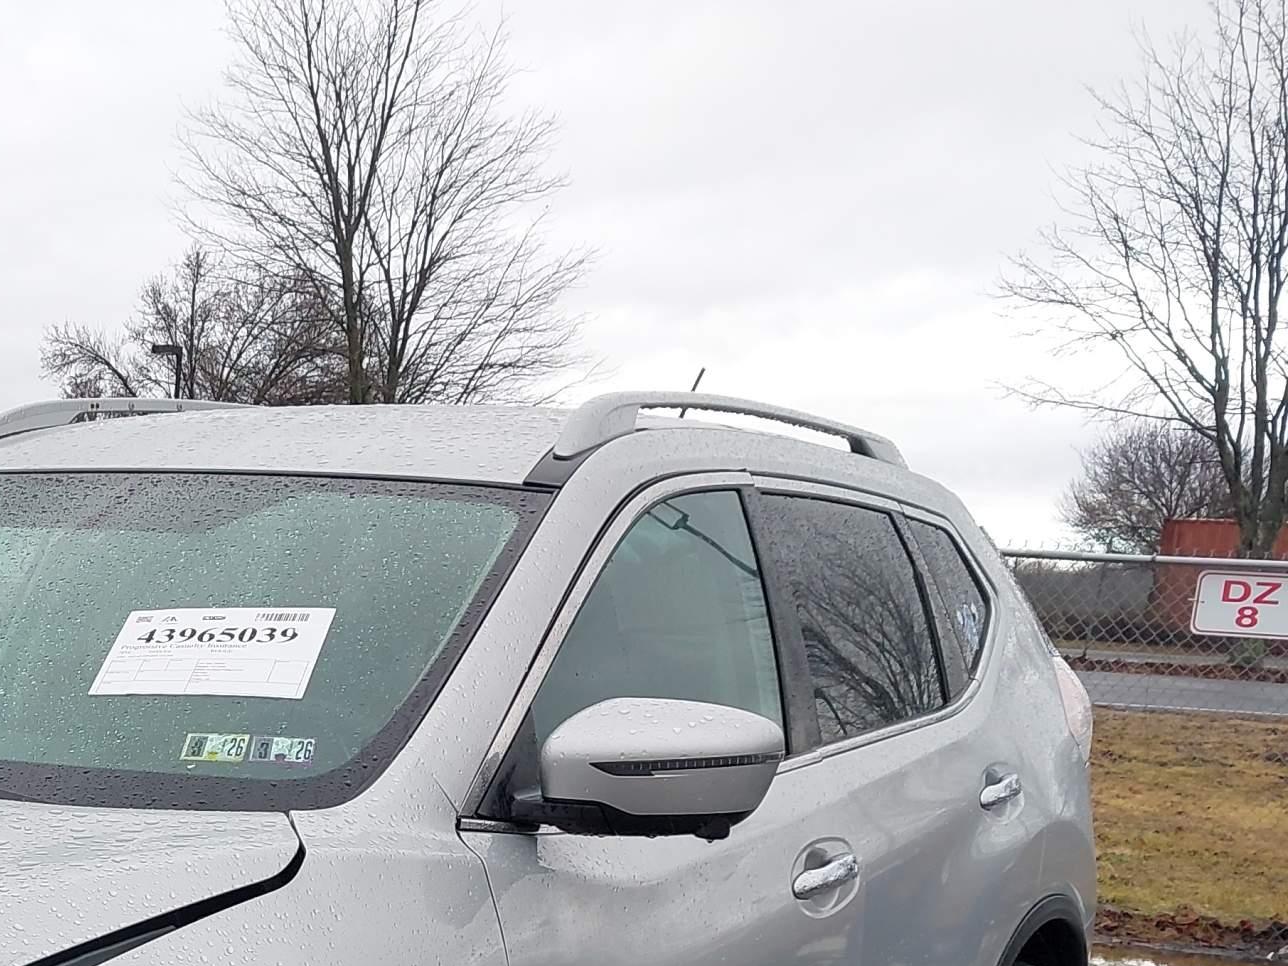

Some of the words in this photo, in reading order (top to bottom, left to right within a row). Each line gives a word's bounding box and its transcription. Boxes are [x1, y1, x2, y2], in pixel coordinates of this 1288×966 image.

[1221, 580, 1282, 605] DZ
[1235, 606, 1259, 628] 8
[136, 627, 299, 644] 43965039
[257, 742, 269, 759] 3
